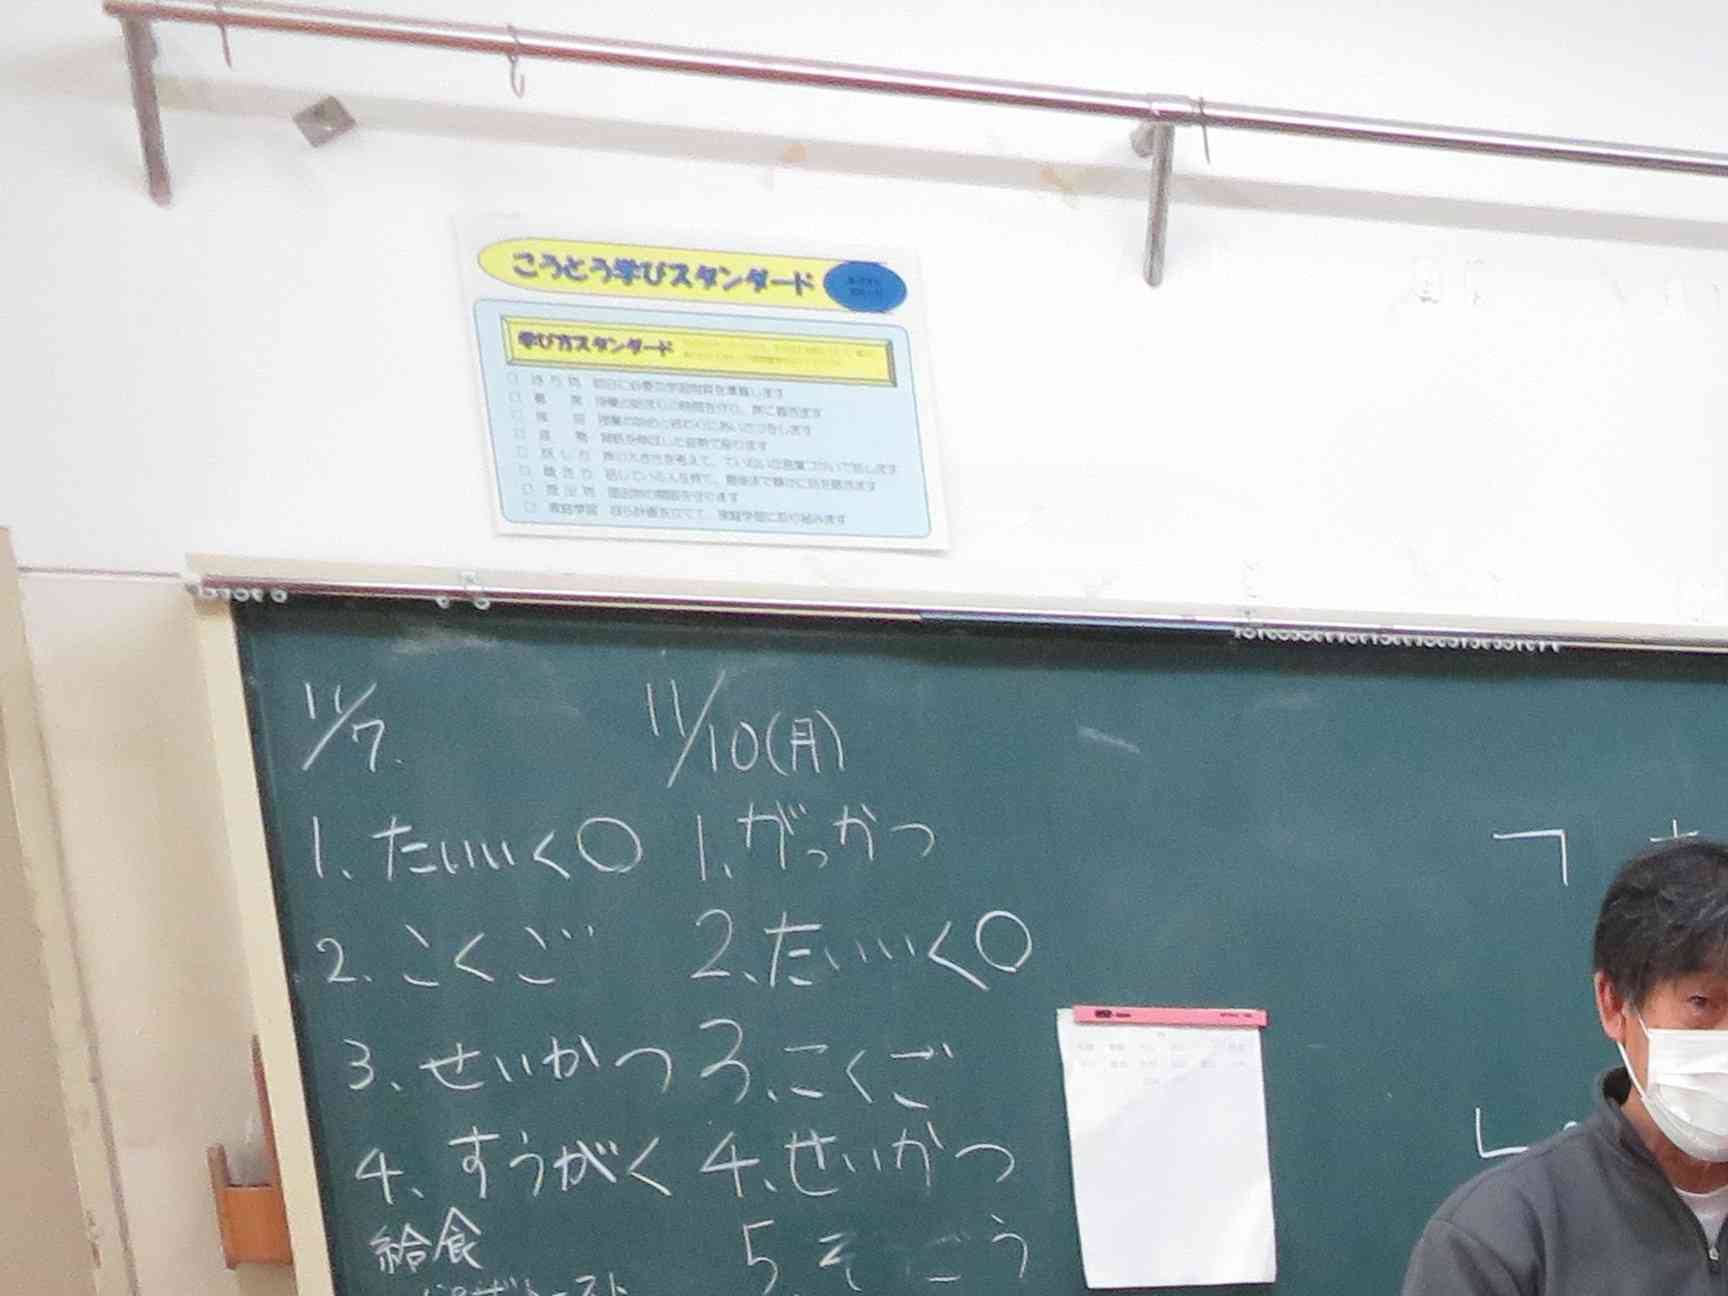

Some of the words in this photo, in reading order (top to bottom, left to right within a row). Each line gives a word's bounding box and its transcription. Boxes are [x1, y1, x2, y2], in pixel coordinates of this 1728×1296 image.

[512, 251, 816, 296] こうとう学びスタンダード
[518, 330, 674, 358] 学び方スタンダード
[368, 1206, 484, 1275] 給食
